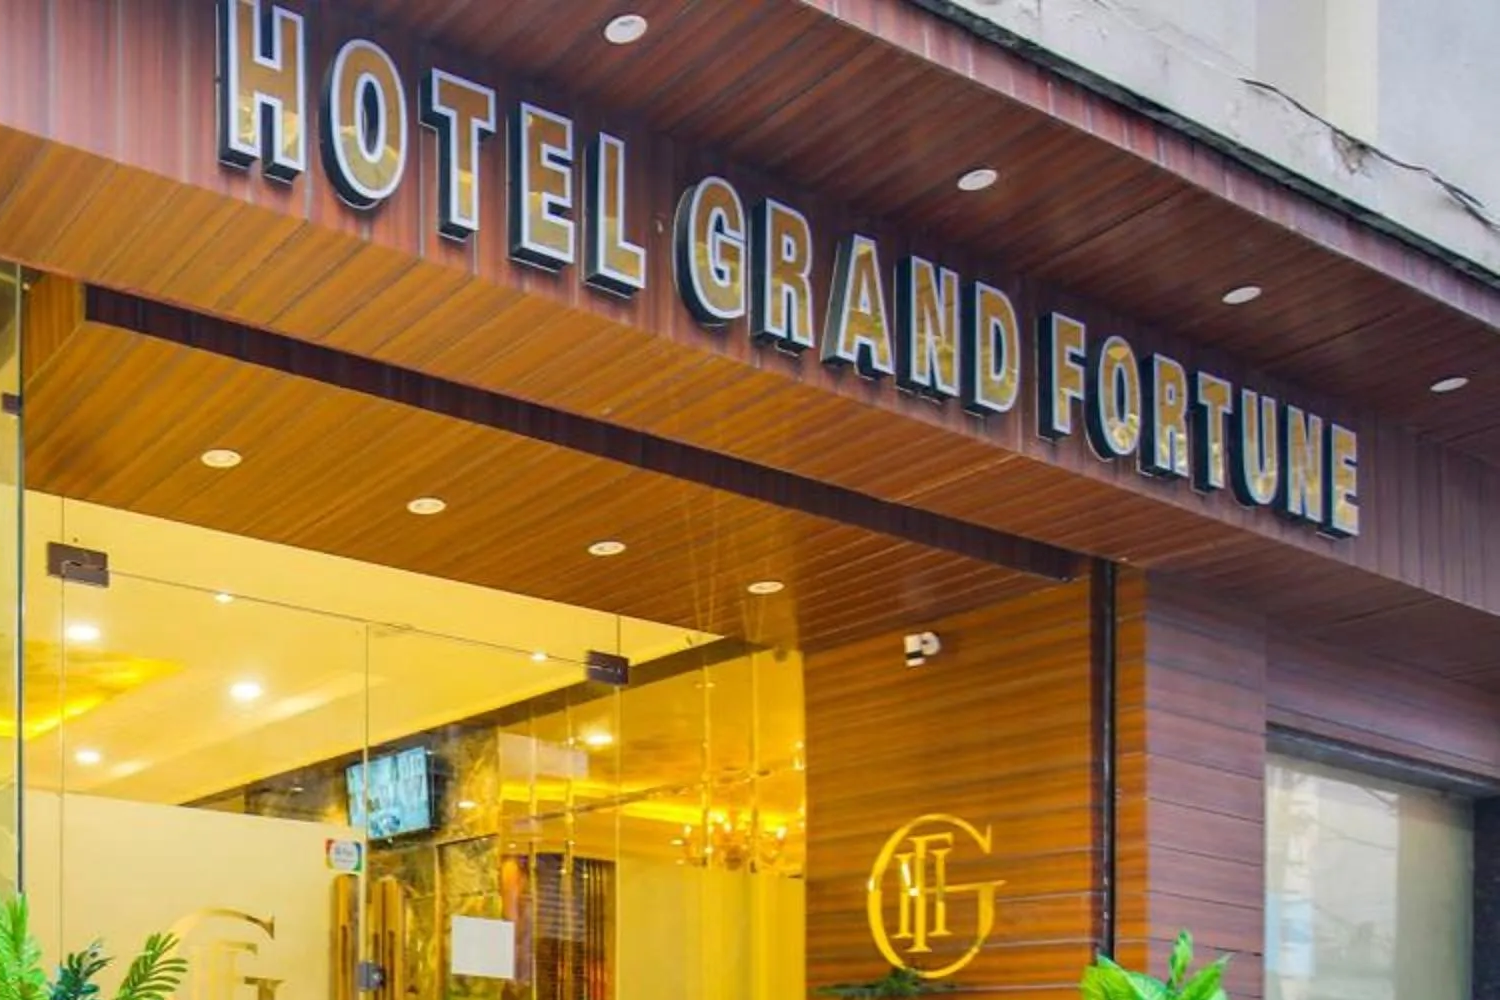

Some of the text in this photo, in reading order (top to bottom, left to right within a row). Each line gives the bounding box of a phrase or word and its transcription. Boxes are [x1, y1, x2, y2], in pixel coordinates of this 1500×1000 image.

[218, 0, 1359, 537] HOTEL GRAND FORTUNE
